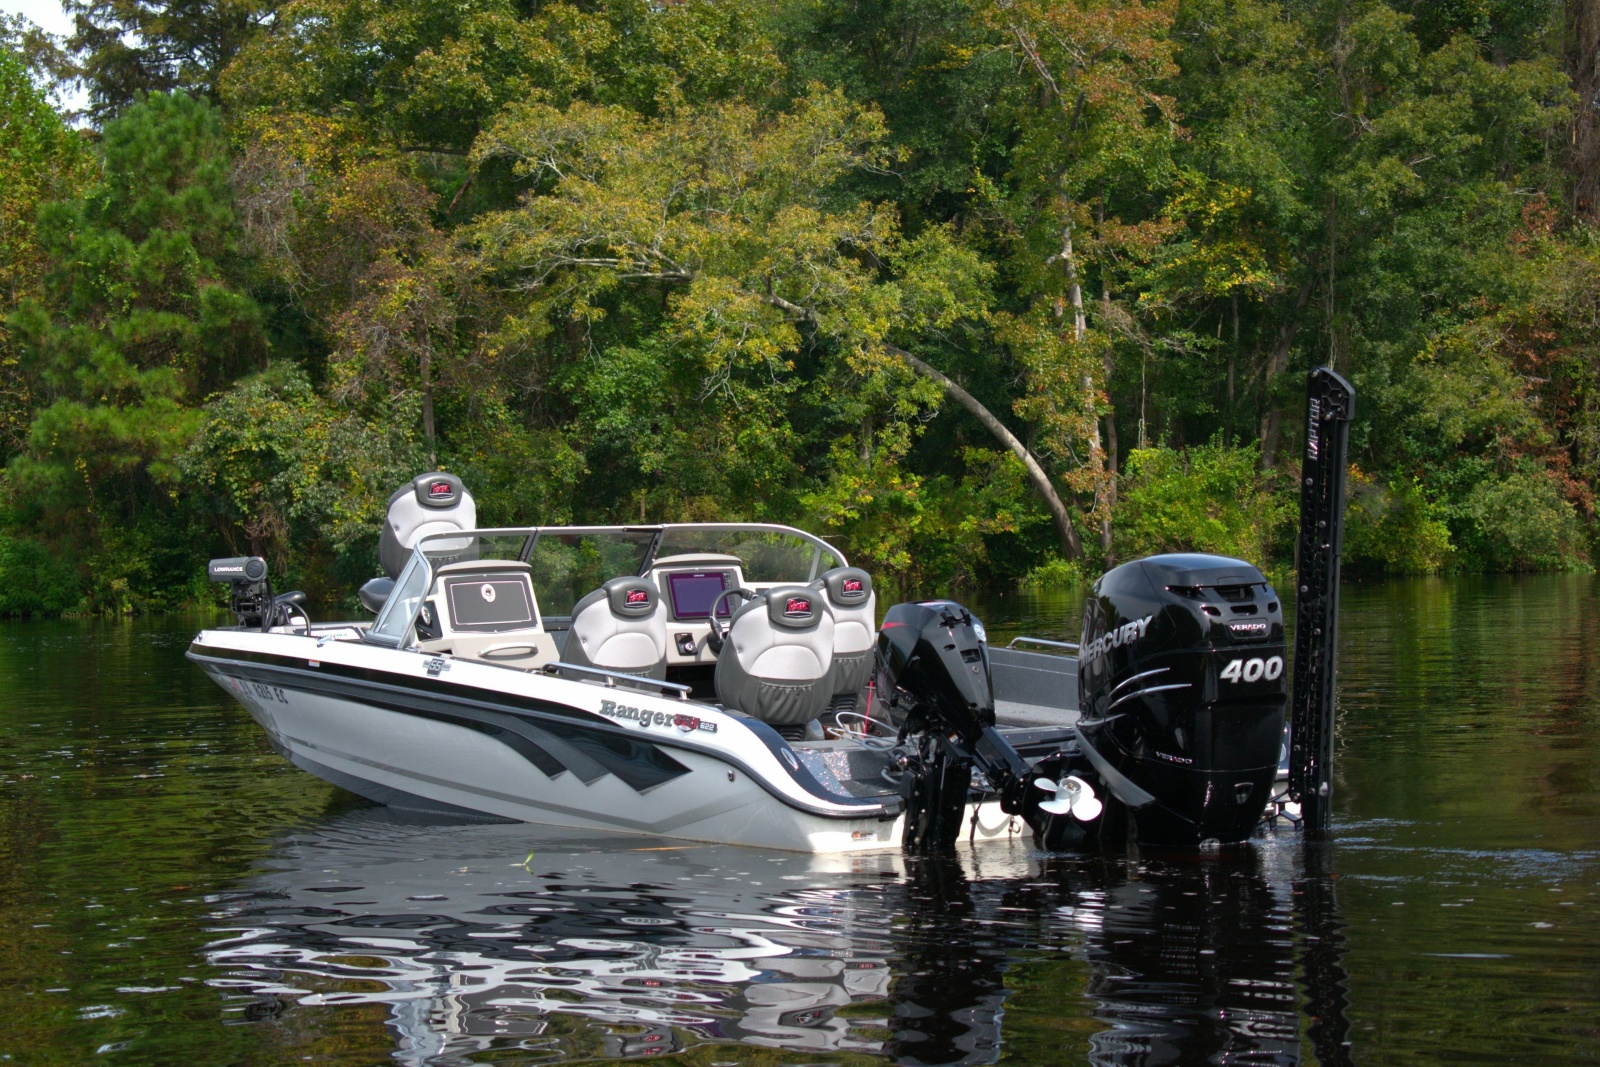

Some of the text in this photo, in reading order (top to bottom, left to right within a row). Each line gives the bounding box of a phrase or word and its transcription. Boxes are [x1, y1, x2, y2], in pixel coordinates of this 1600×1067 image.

[1308, 397, 1320, 460] RAPTOR
[1230, 623, 1267, 631] VERADO
[1079, 615, 1153, 669] MERCURY
[1219, 655, 1283, 684] 400
[273, 687, 289, 704] EC
[599, 699, 677, 728] Ranger
[699, 722, 715, 731] 622
